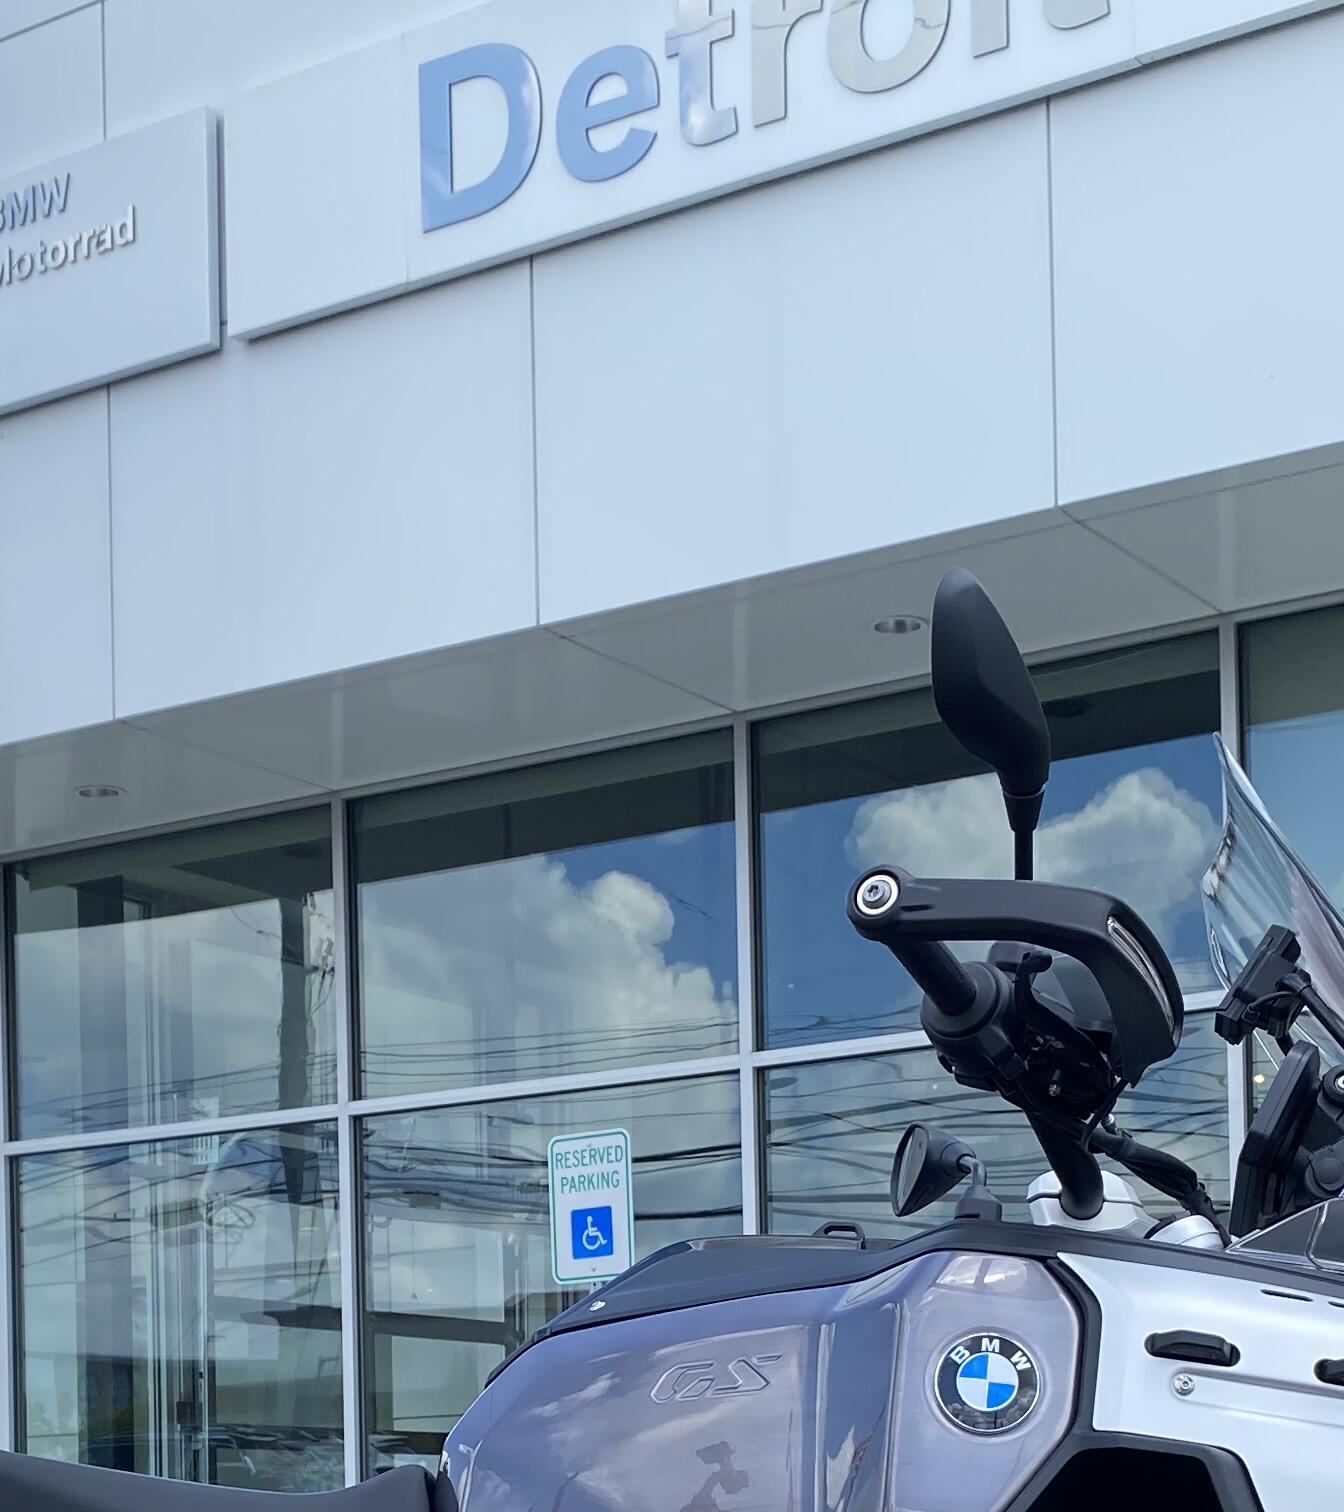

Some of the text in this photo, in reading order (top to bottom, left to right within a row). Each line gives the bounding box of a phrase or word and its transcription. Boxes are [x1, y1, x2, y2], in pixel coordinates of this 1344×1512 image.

[418, 0, 1109, 233] Detro
[556, 1145, 624, 1169] RESERVED
[561, 1170, 620, 1194] PARKING
[949, 1337, 1031, 1371] BMW
[650, 1352, 783, 1403] GS
